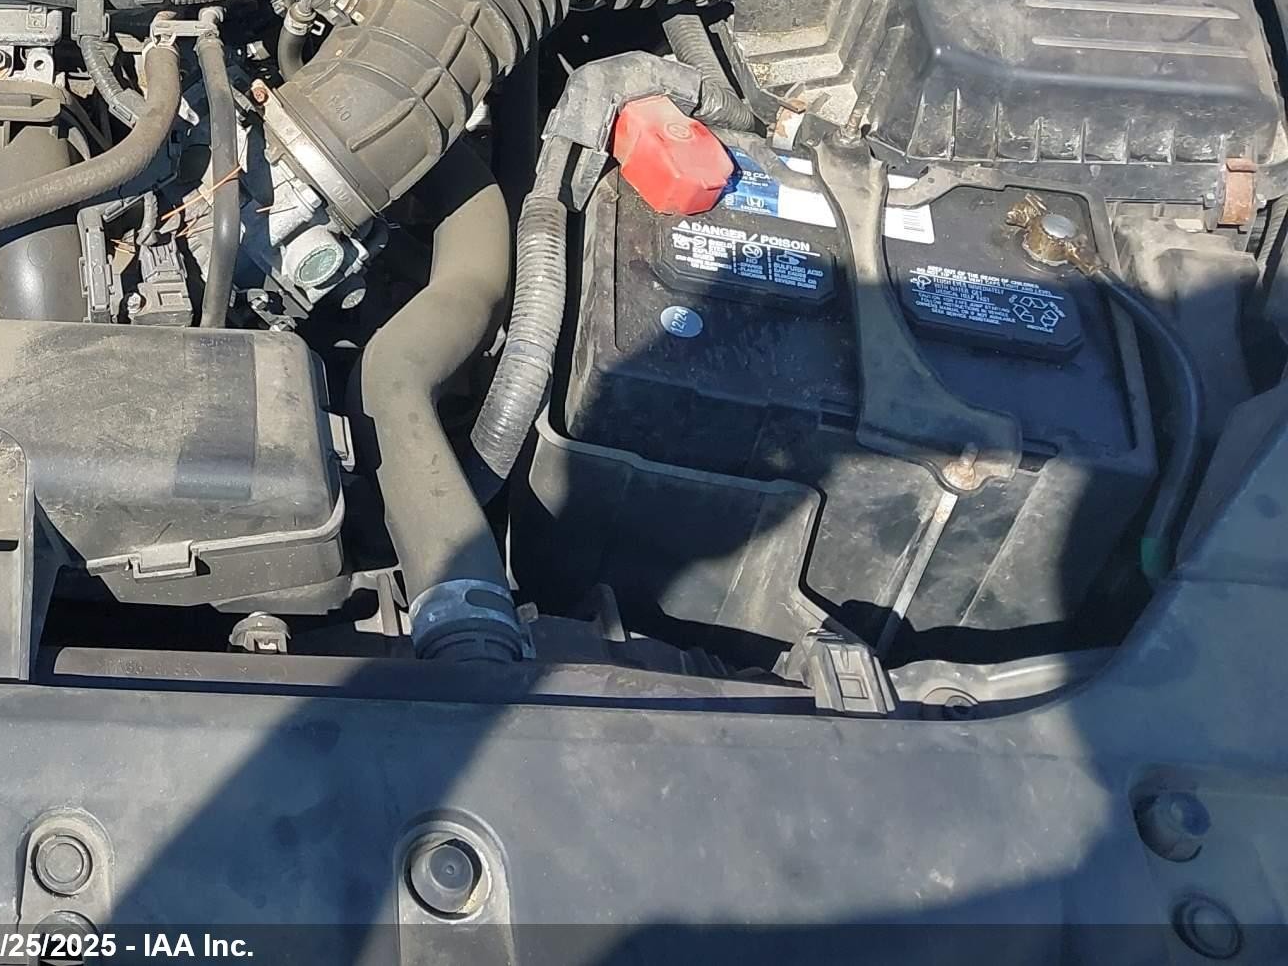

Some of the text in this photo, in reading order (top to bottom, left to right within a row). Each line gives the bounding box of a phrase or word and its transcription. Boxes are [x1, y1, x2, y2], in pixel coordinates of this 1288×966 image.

[691, 222, 747, 241] DANGER
[760, 235, 810, 252] POISON
[670, 308, 689, 333] 12/24
